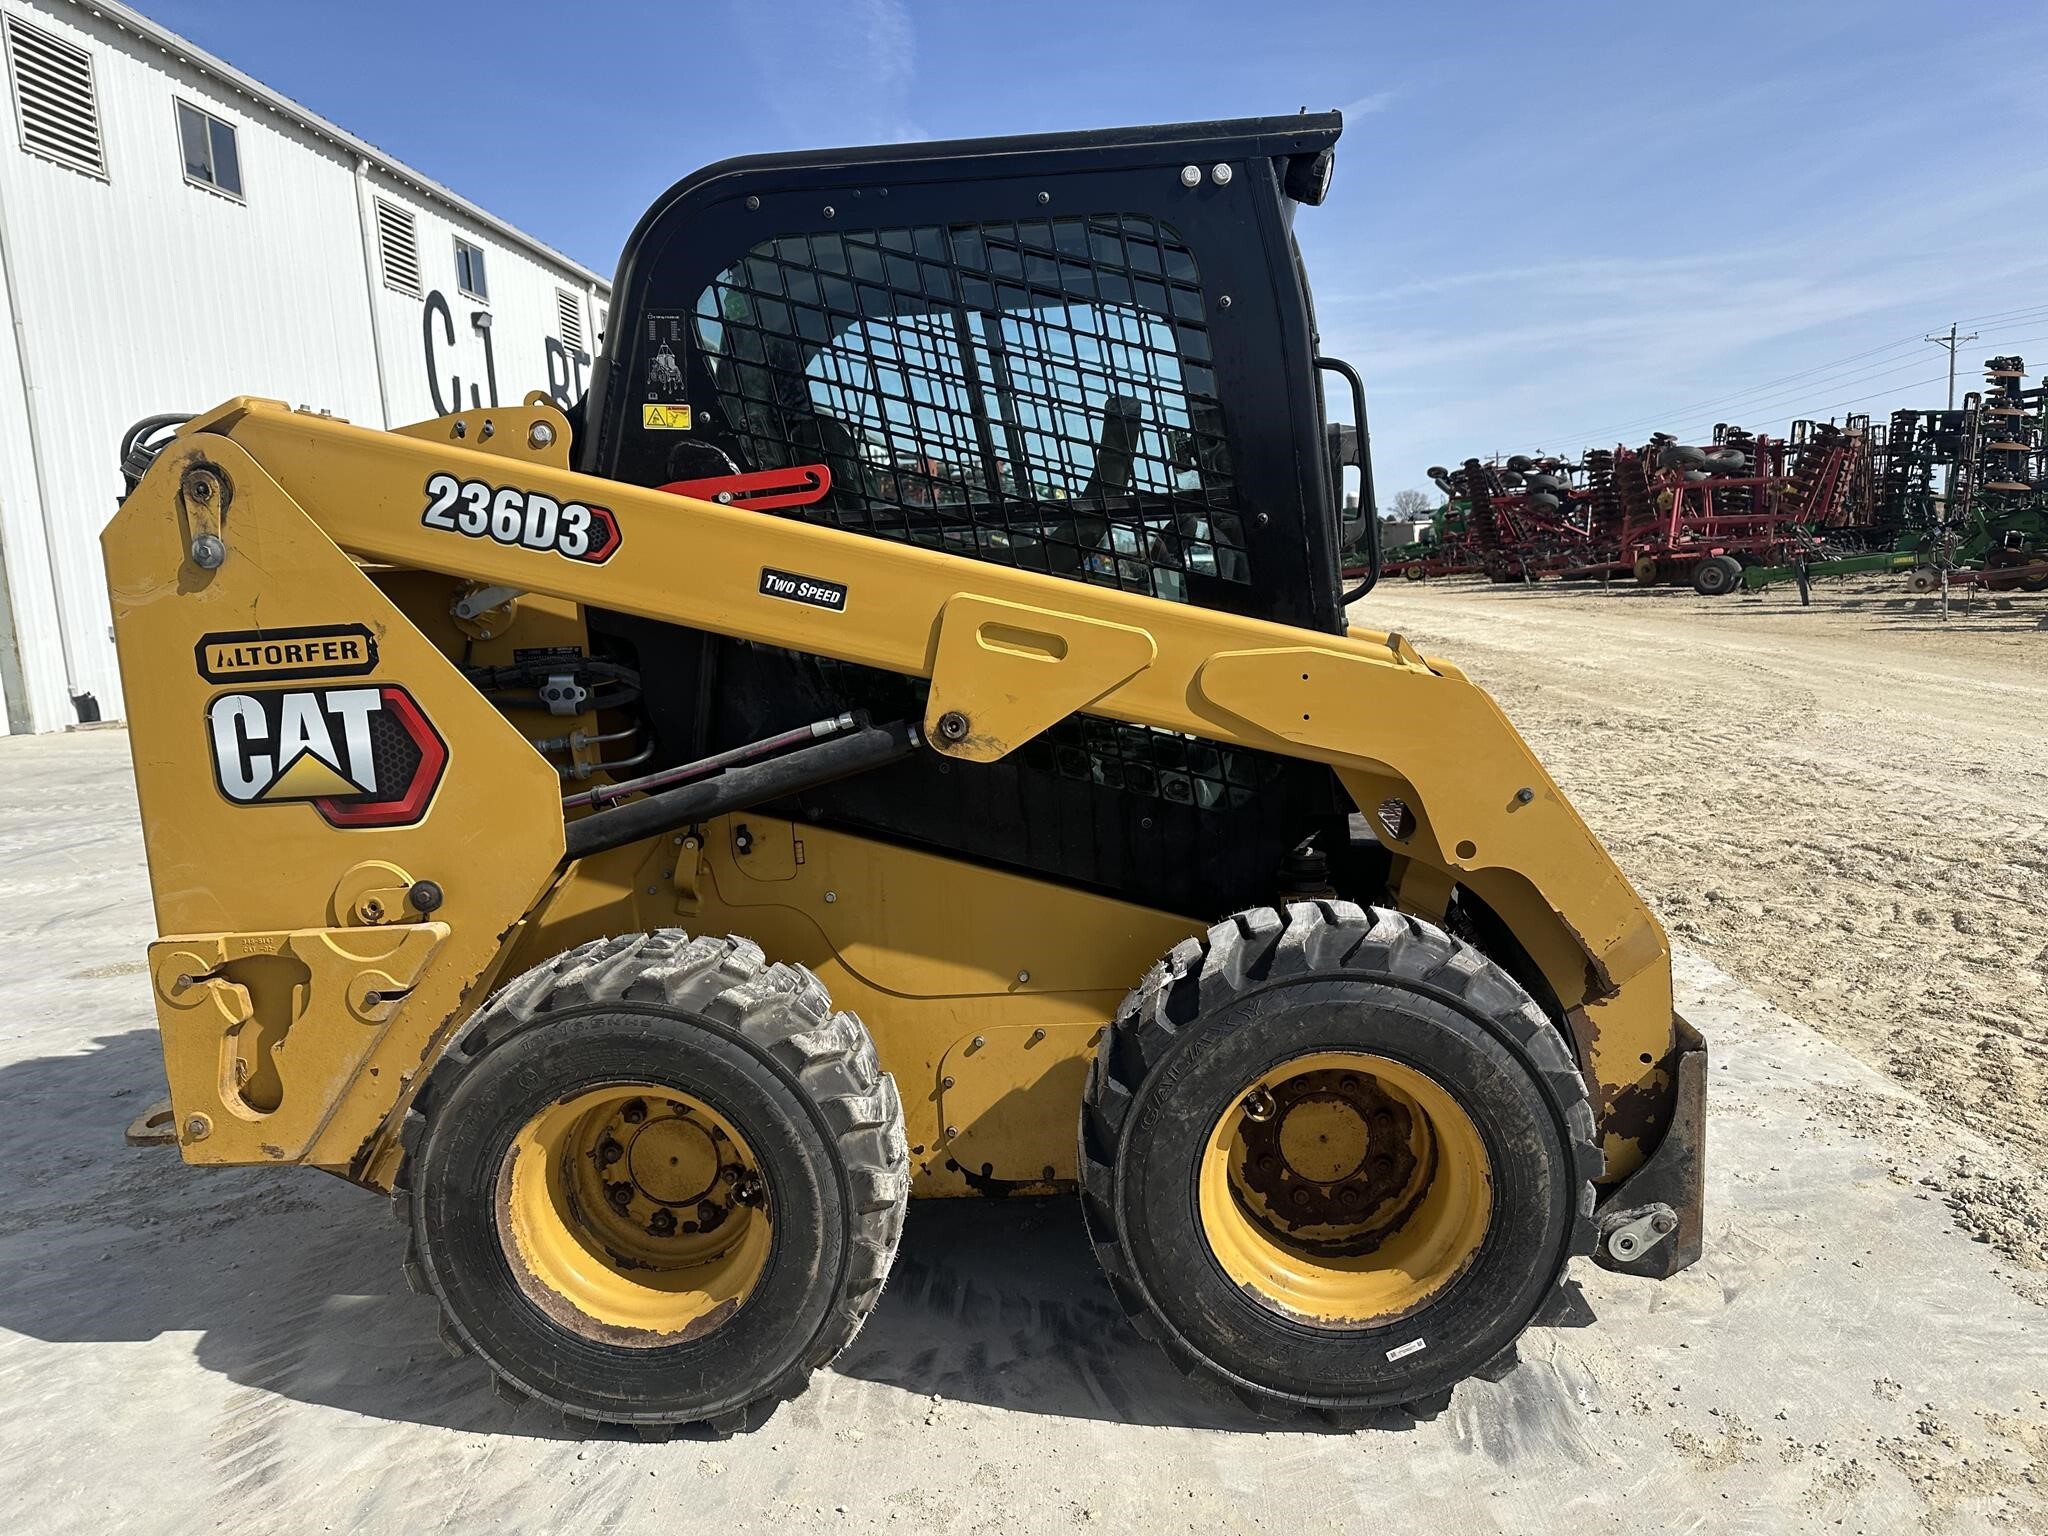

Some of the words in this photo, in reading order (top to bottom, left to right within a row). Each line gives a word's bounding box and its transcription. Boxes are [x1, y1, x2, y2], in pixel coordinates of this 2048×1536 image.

[425, 475, 592, 556] 236D3
[216, 640, 360, 668] ALTORFER
[211, 688, 382, 800] CAT
[1141, 999, 1262, 1130] GALAXY
